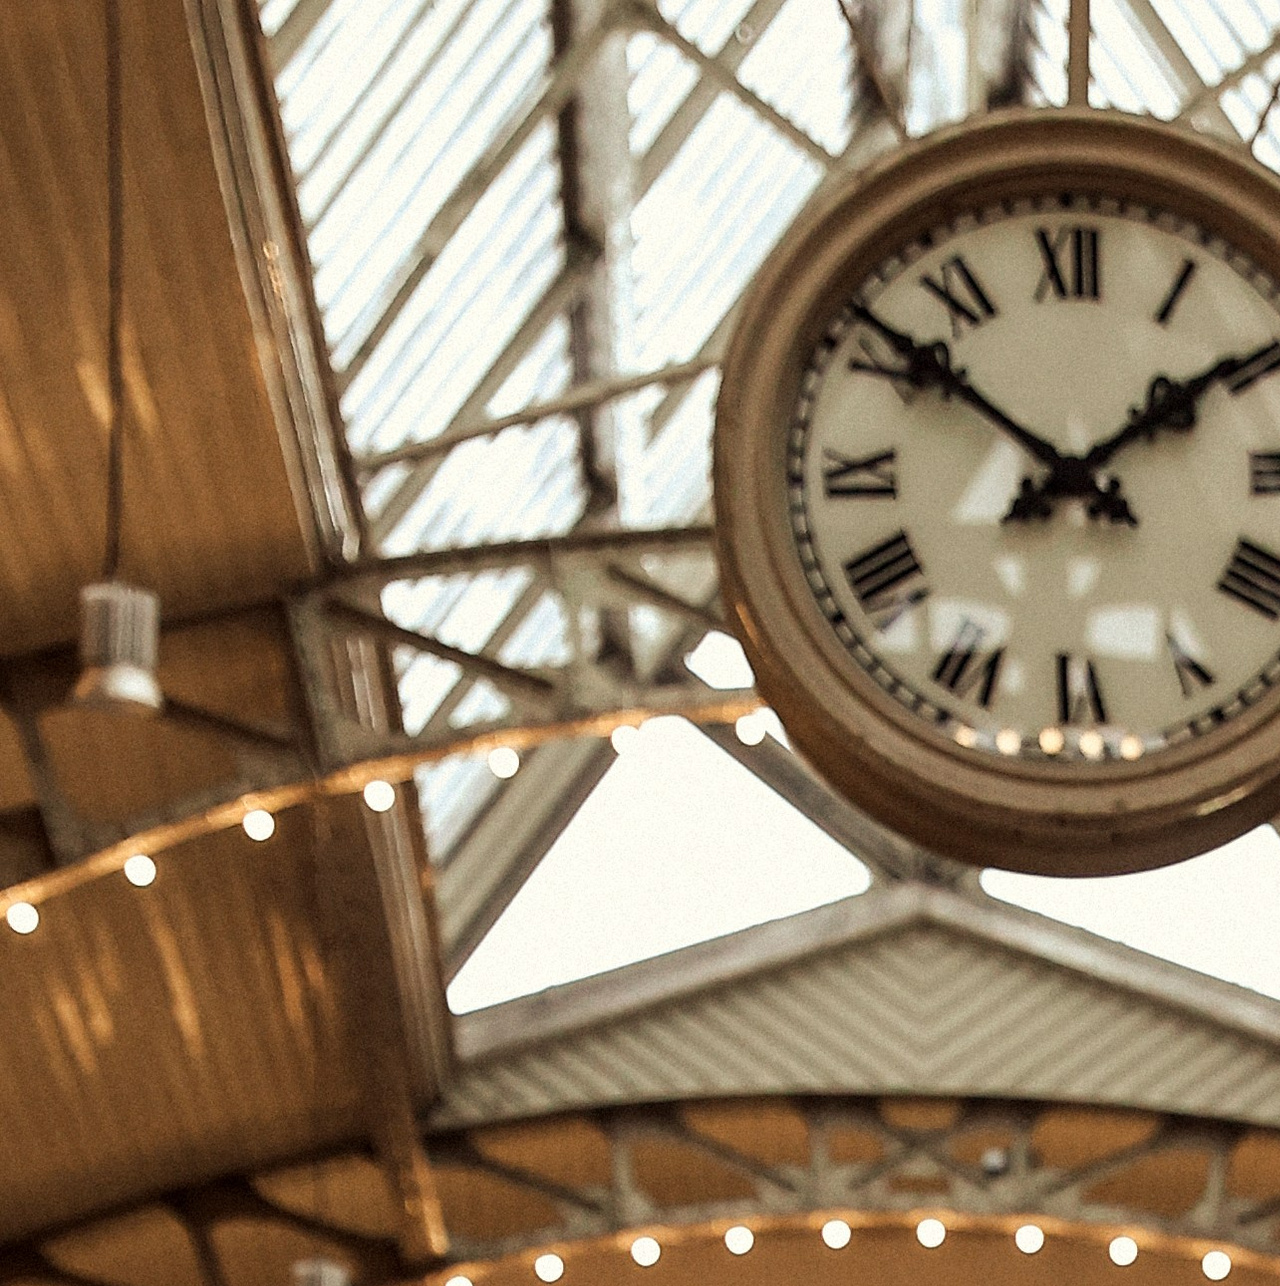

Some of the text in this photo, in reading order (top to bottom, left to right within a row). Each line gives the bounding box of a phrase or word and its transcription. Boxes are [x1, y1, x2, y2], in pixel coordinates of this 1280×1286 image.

[919, 254, 996, 338] XI
[1033, 226, 1101, 302] XII
[1156, 260, 1195, 326] I
[823, 447, 897, 500] IX
[842, 529, 928, 634] VIII
[932, 614, 1006, 710] VII
[1055, 653, 1106, 724] VI
[1166, 628, 1214, 698] V
